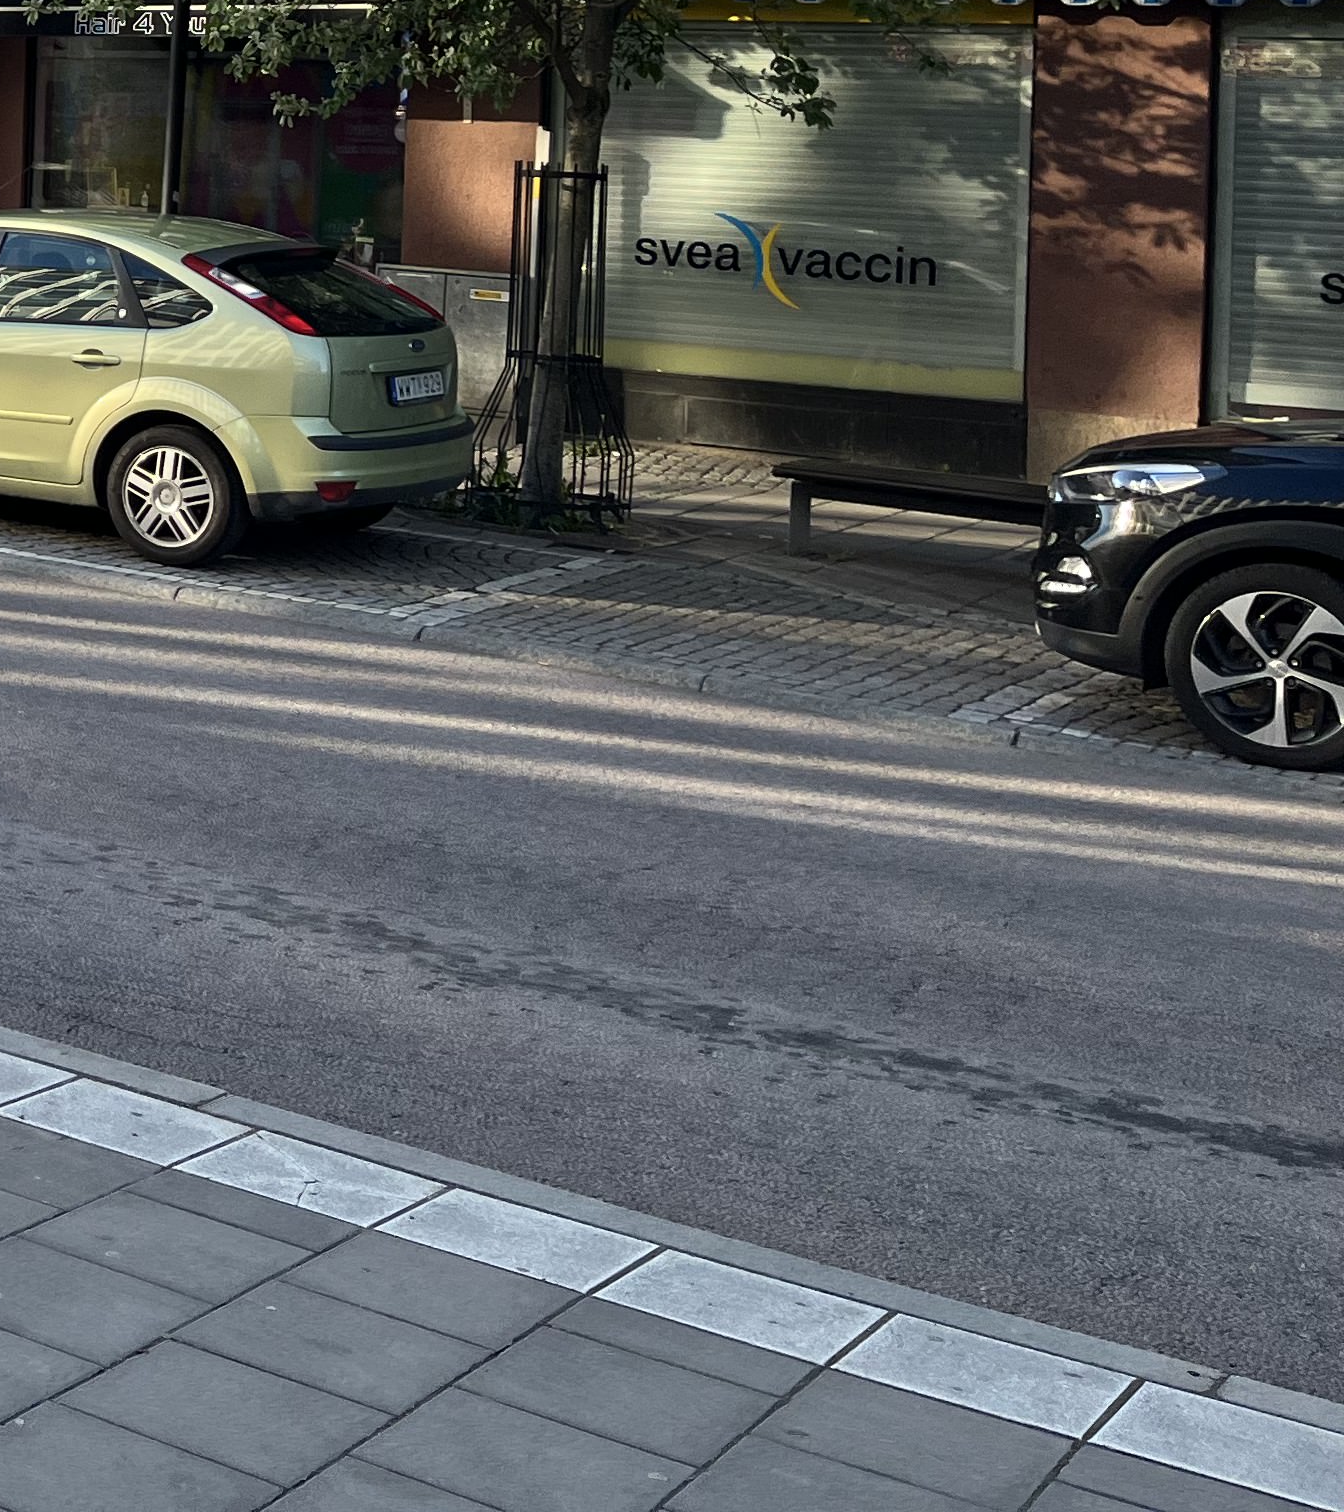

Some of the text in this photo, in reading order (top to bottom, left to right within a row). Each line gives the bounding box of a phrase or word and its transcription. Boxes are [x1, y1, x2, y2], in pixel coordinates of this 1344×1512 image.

[74, 11, 206, 35] Hair 4 Yu
[634, 237, 938, 287] svea vaccin
